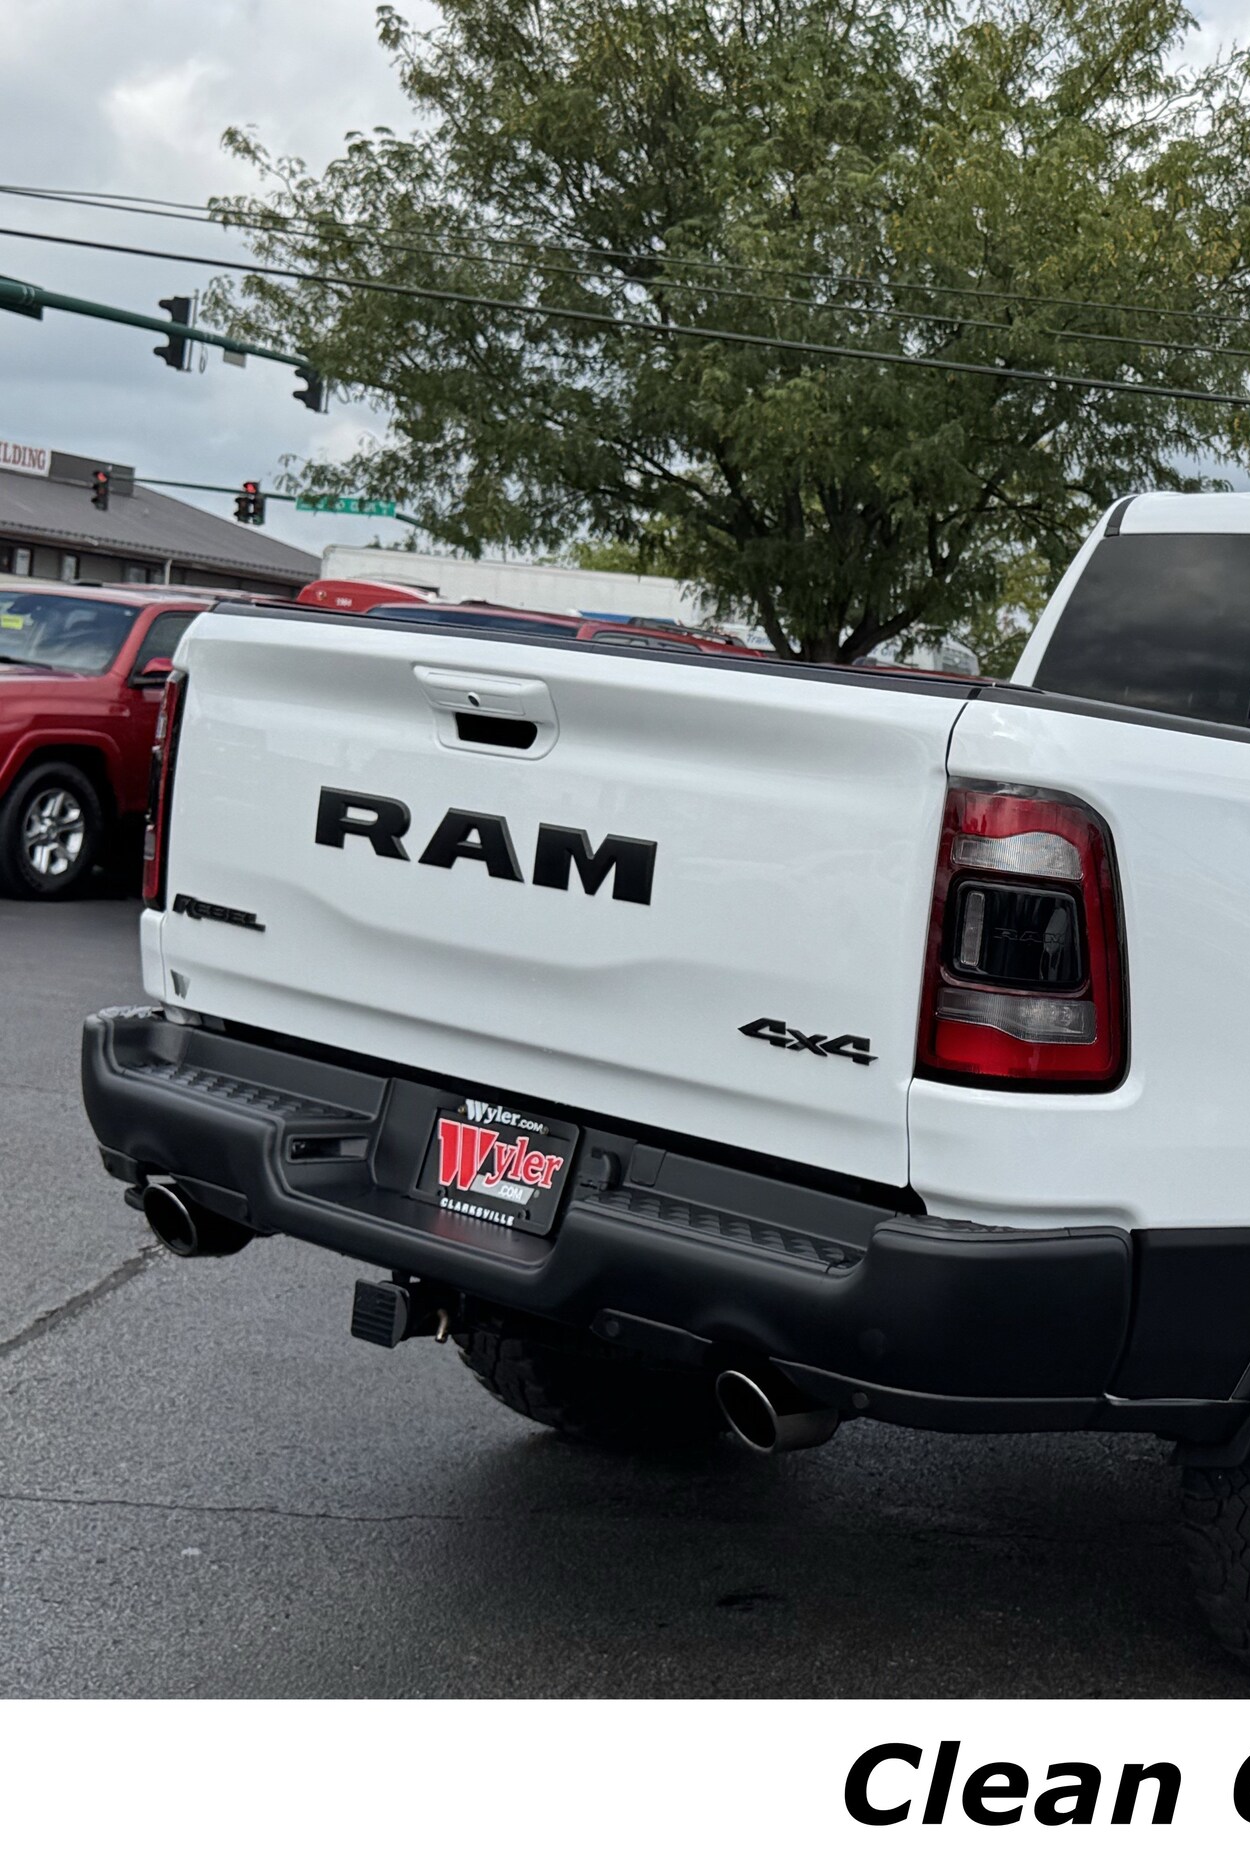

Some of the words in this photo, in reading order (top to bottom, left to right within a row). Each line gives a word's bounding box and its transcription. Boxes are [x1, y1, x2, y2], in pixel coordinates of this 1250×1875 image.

[0, 441, 46, 470] LDING
[315, 786, 658, 906] RAM
[172, 893, 266, 933] REBEL
[438, 1118, 564, 1191] Wyler
[439, 1197, 514, 1227] CLARKSVILLE
